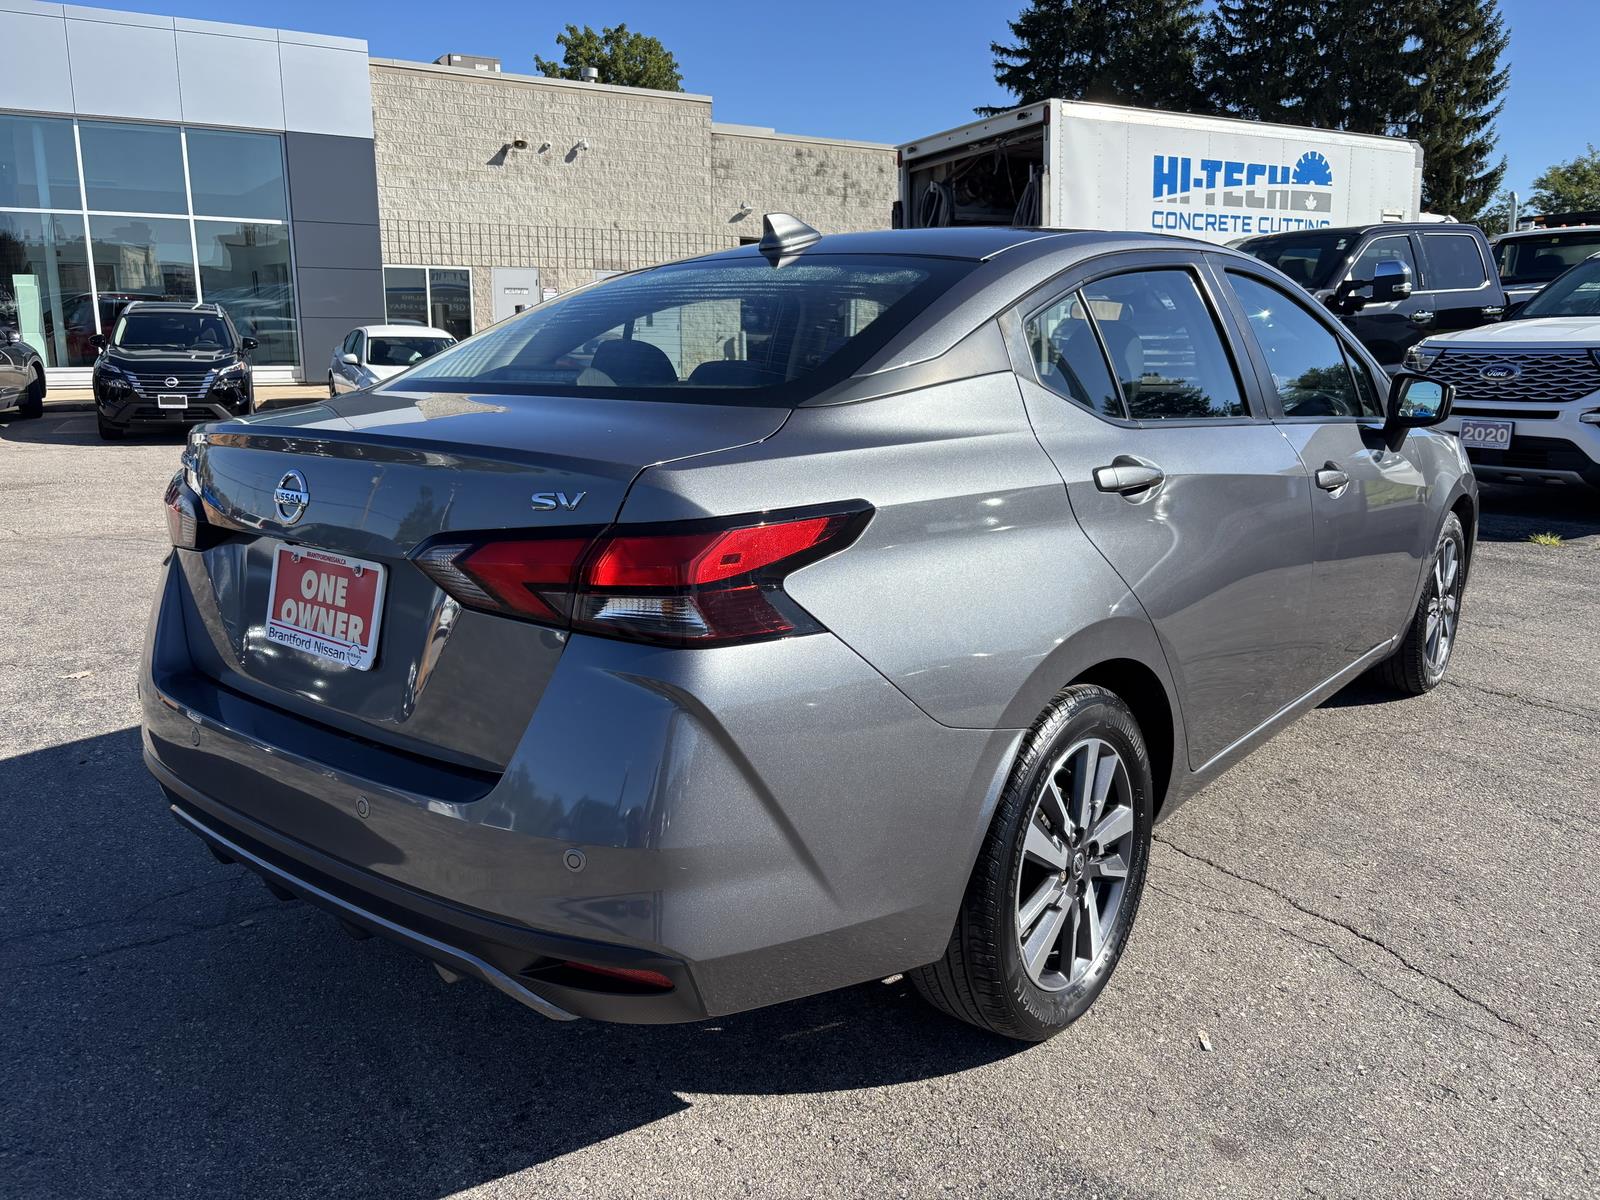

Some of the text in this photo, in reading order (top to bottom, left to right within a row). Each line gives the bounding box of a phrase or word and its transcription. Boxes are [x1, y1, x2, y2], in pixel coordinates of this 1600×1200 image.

[1153, 155, 1290, 209] HI-TECH
[1152, 210, 1252, 233] CONCRETE
[1487, 368, 1508, 377] Ford
[1462, 427, 1508, 442] 2020
[531, 489, 587, 511] SV
[300, 569, 349, 608] ONE
[281, 598, 364, 645] OWNER
[269, 626, 346, 661] Brantford Nissan
